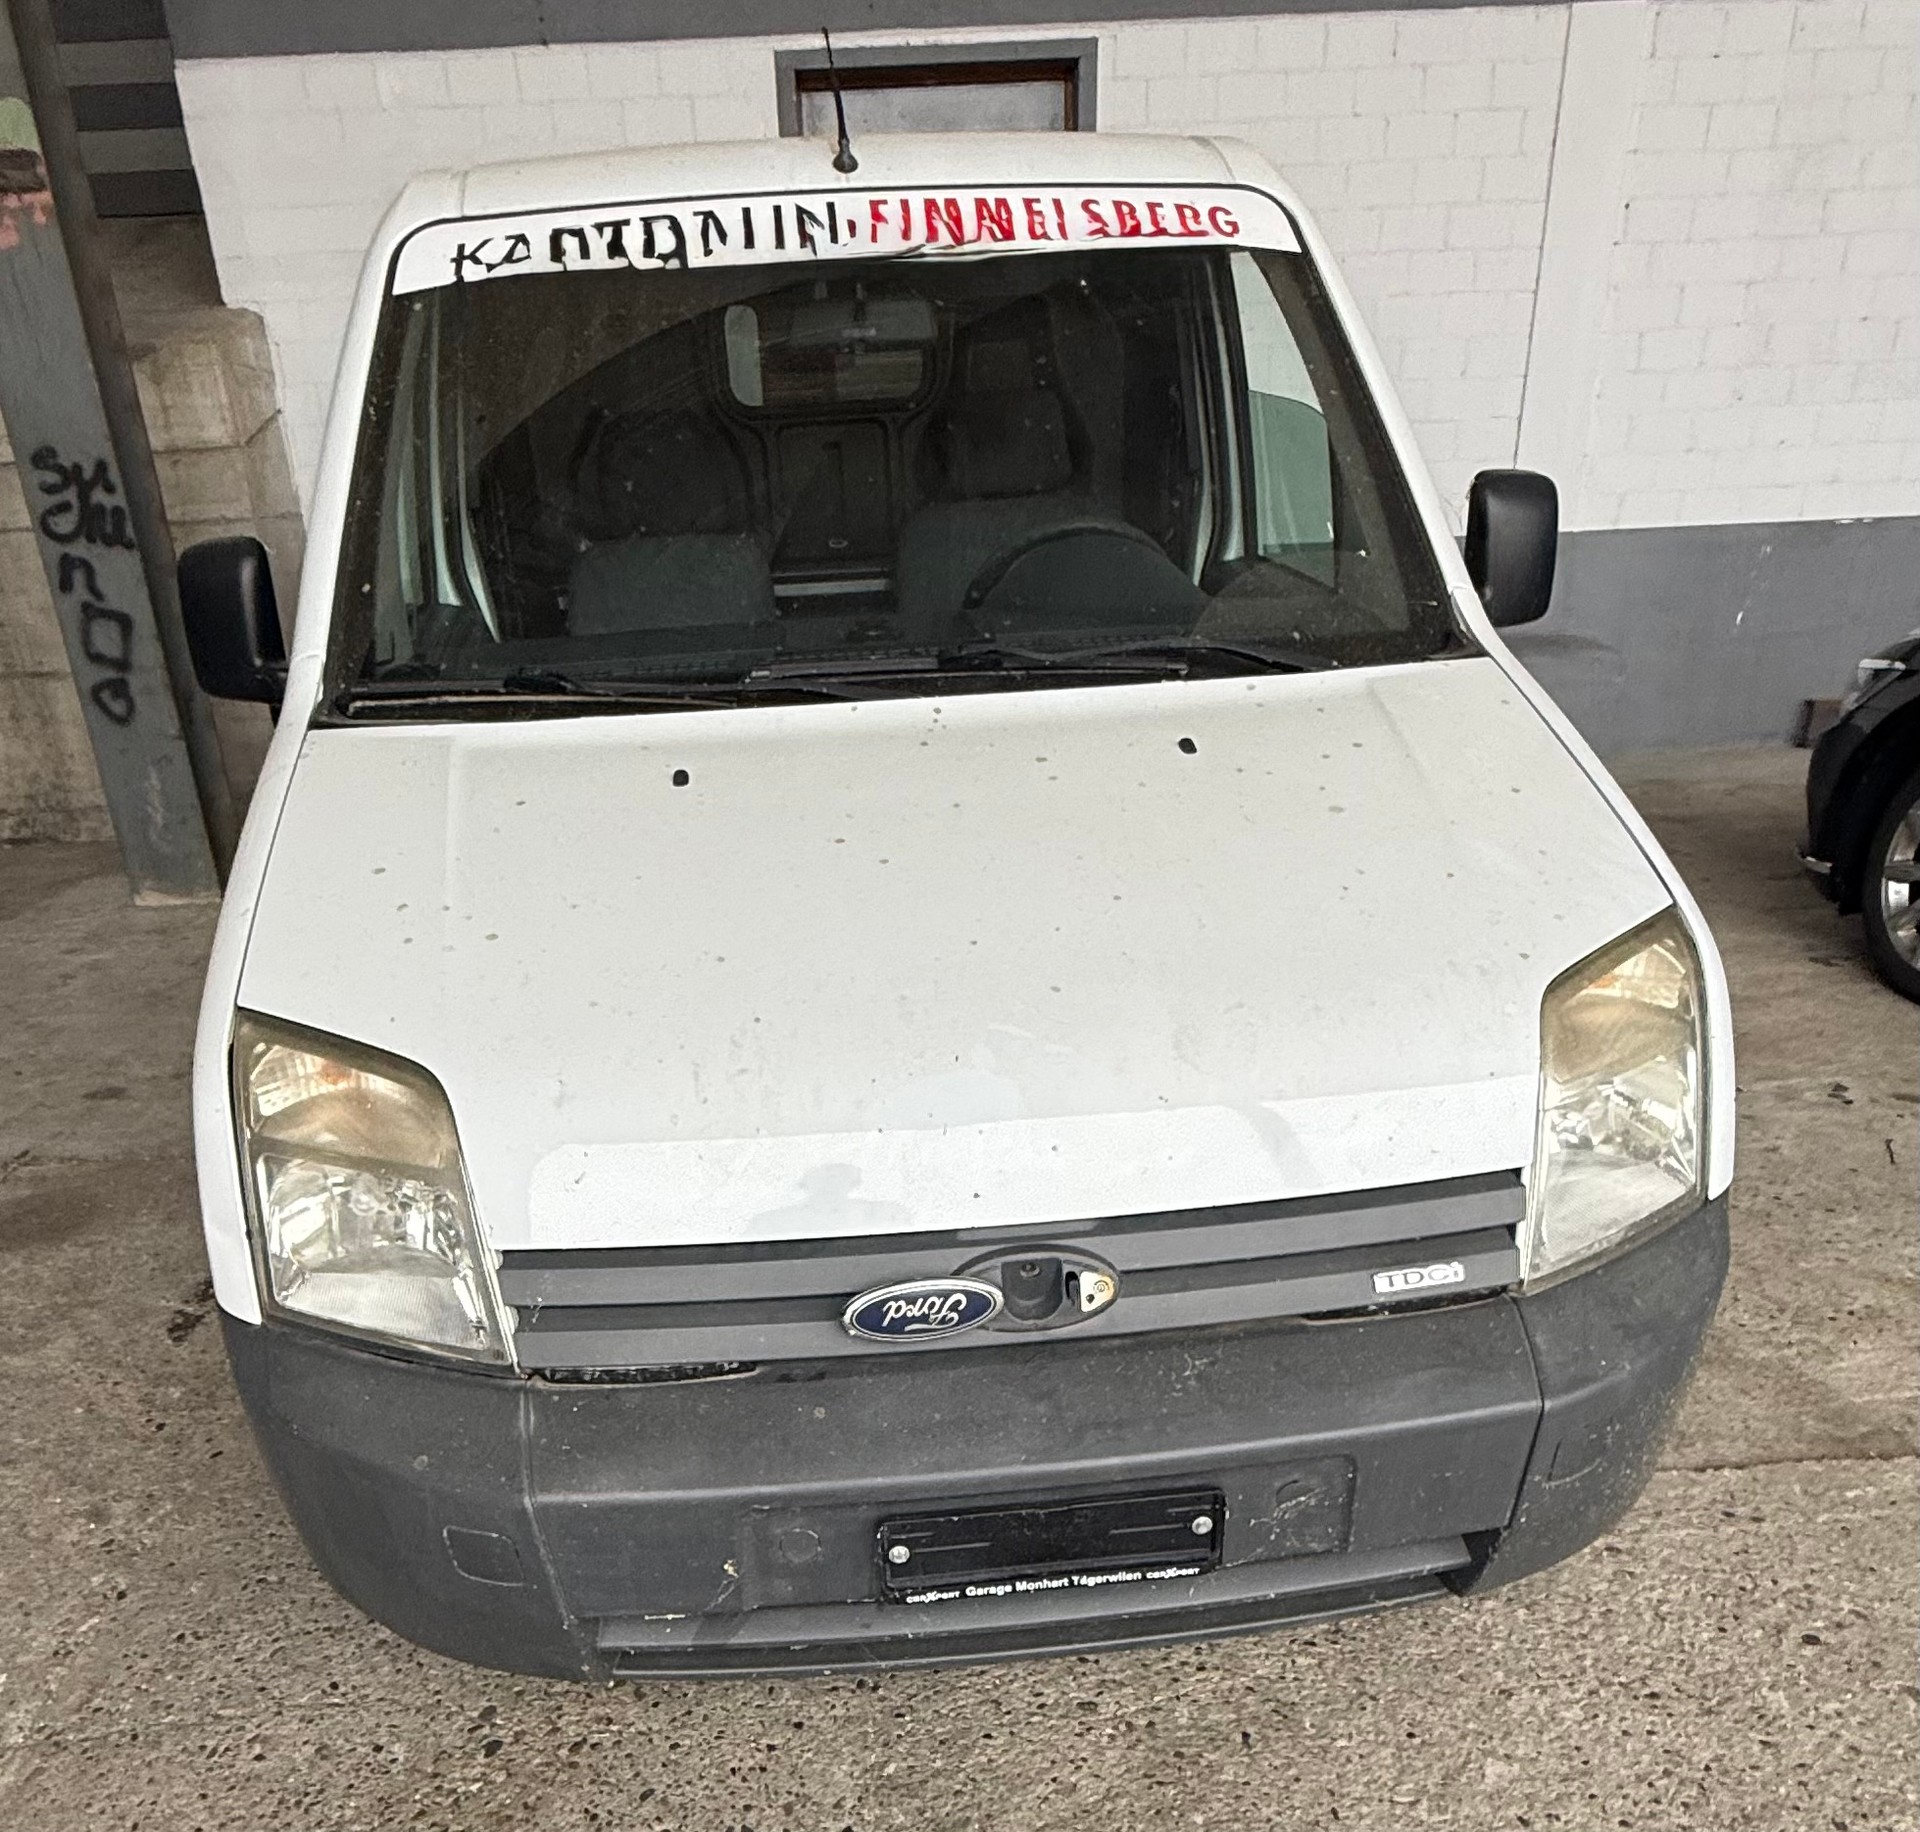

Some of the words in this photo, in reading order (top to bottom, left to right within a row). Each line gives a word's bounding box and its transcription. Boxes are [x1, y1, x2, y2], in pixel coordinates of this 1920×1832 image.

[881, 1292, 968, 1333] Ford
[965, 1584, 1013, 1597] Garage
[1015, 1577, 1069, 1592] Monhart
